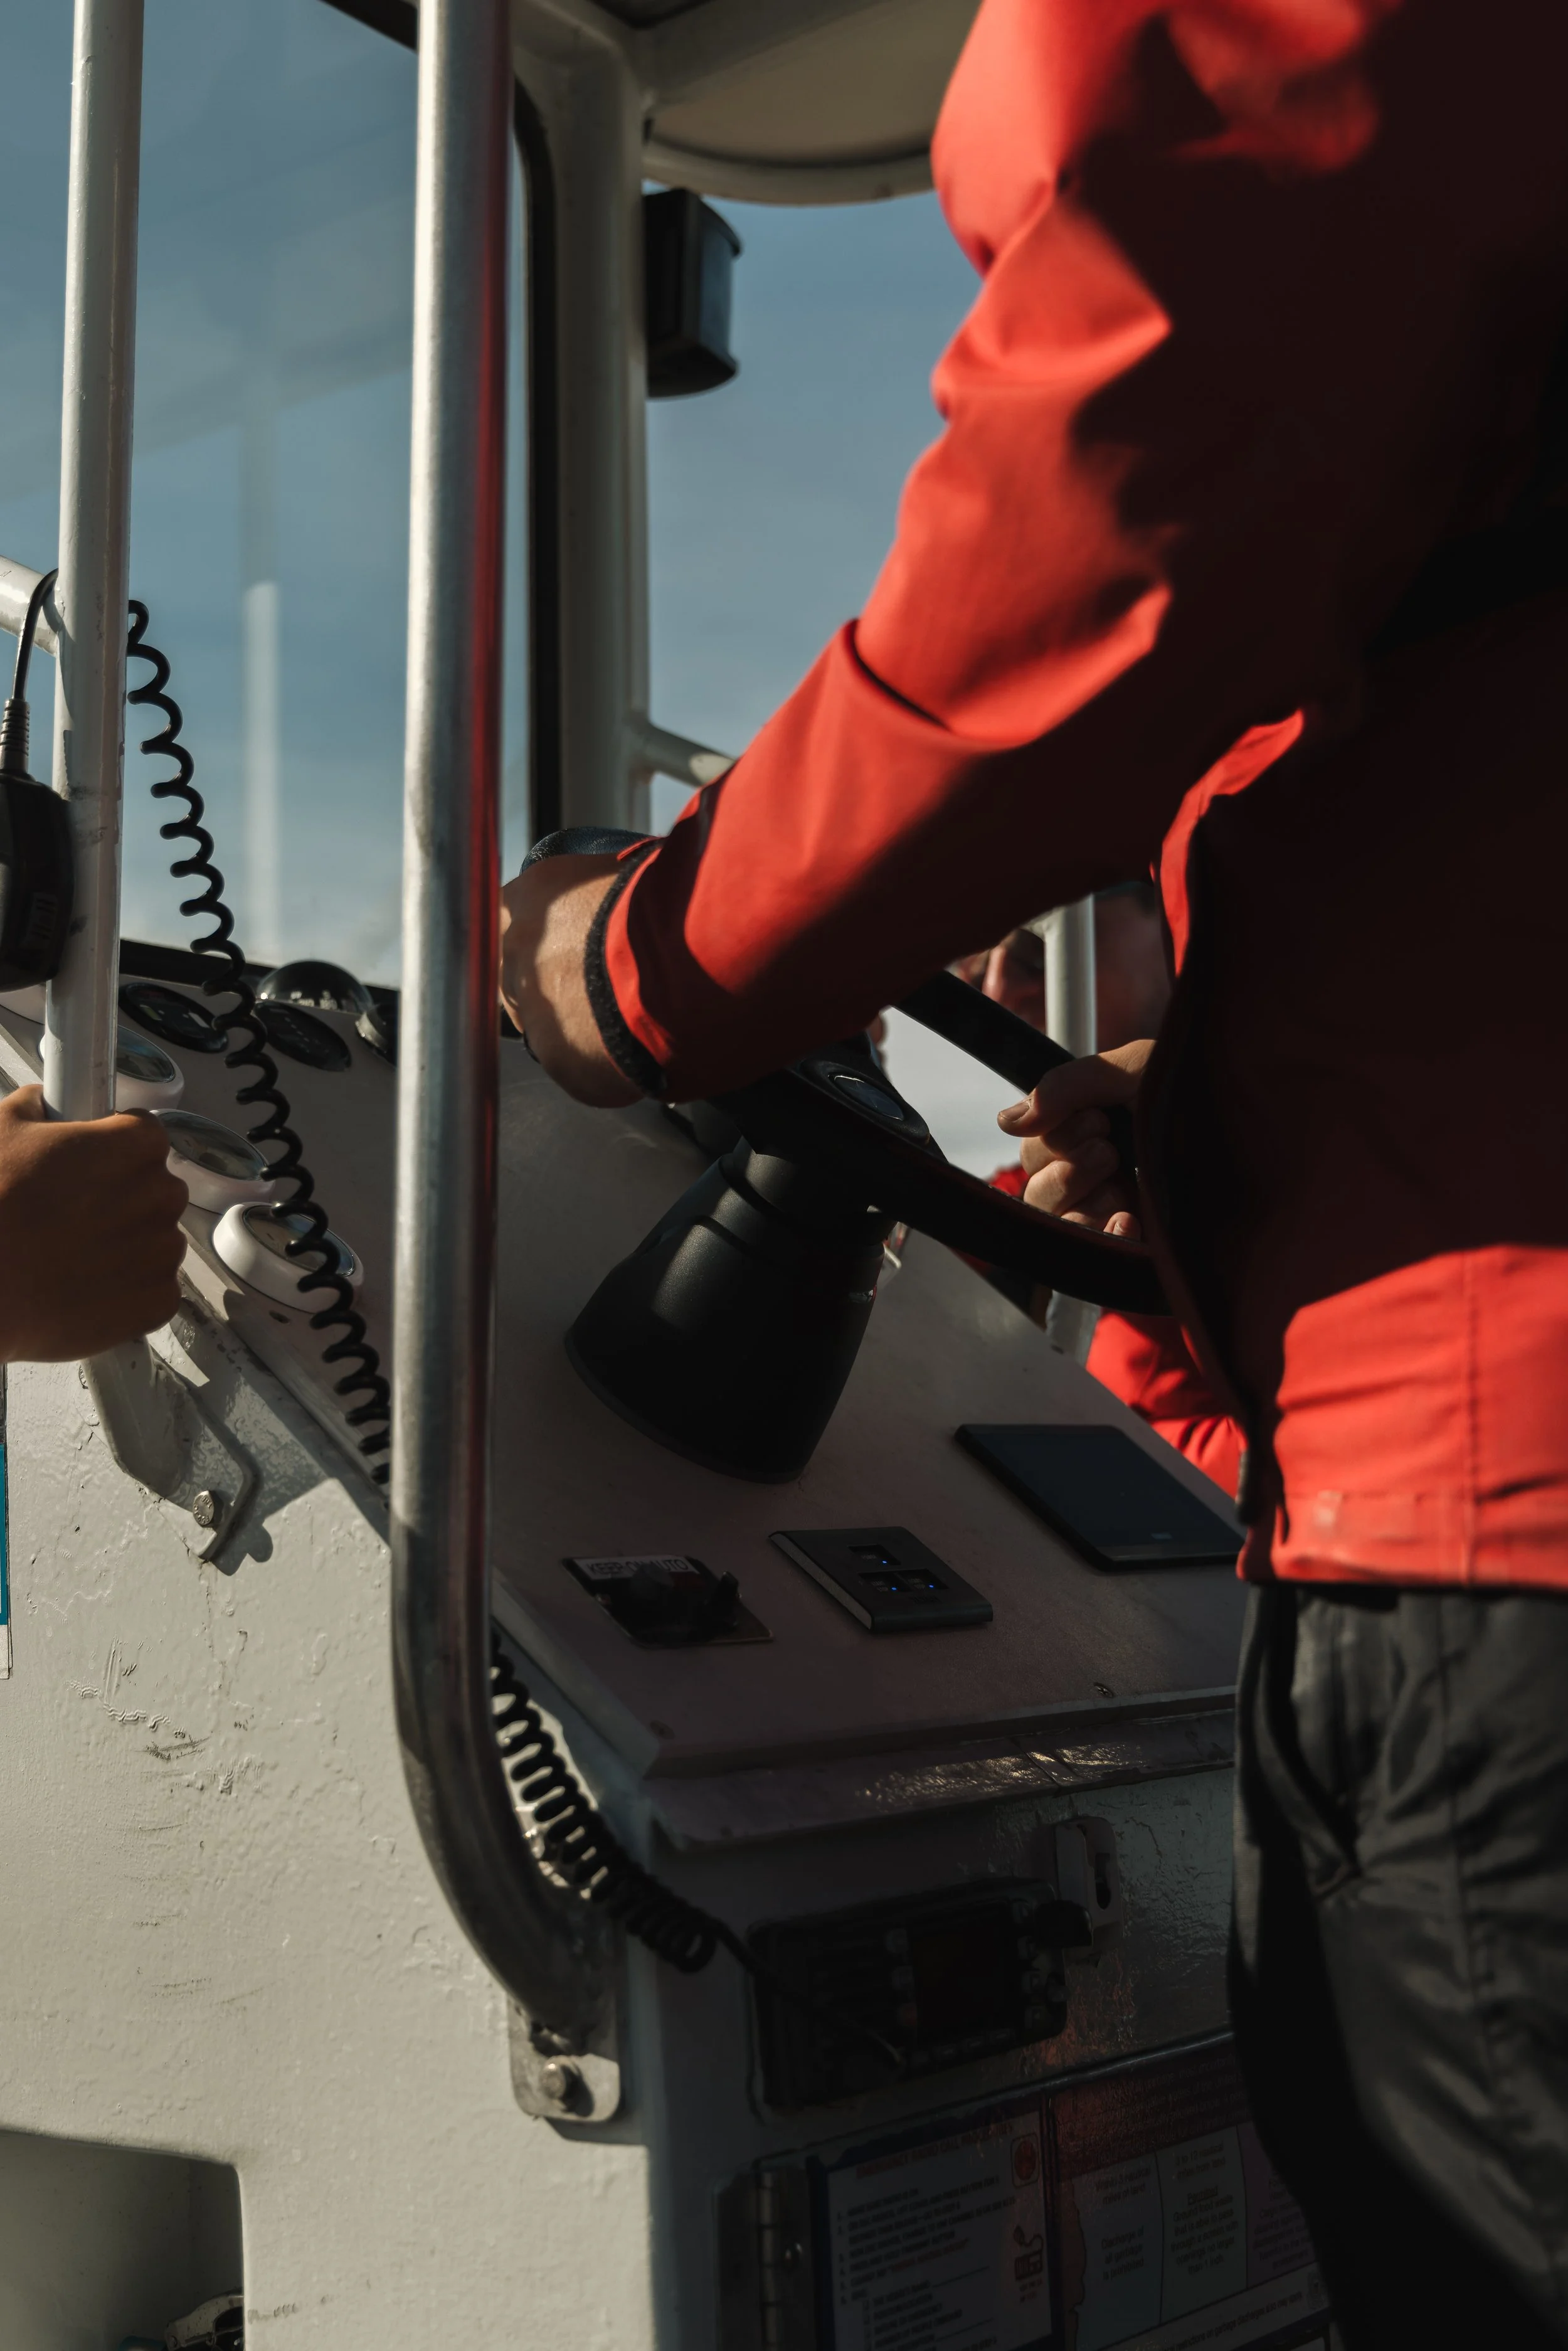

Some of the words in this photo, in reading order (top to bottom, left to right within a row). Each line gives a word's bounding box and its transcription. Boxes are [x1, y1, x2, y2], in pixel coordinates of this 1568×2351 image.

[588, 1561, 623, 1575] KEEP
[1190, 2150, 1198, 2162] 12
[1173, 2205, 1198, 2222] Ground
[1199, 2199, 1214, 2210] food
[1101, 2231, 1136, 2250] Discharge
[1138, 2225, 1144, 2237] of
[1171, 2235, 1195, 2252] through
[1225, 2220, 1238, 2233] with
[1174, 2225, 1187, 2237] that
[1104, 2252, 1113, 2264] all
[1176, 2248, 1205, 2266] openings
[1207, 2244, 1216, 2253] no
[1110, 2257, 1144, 2281] prohibited
[1188, 2262, 1203, 2275] than
